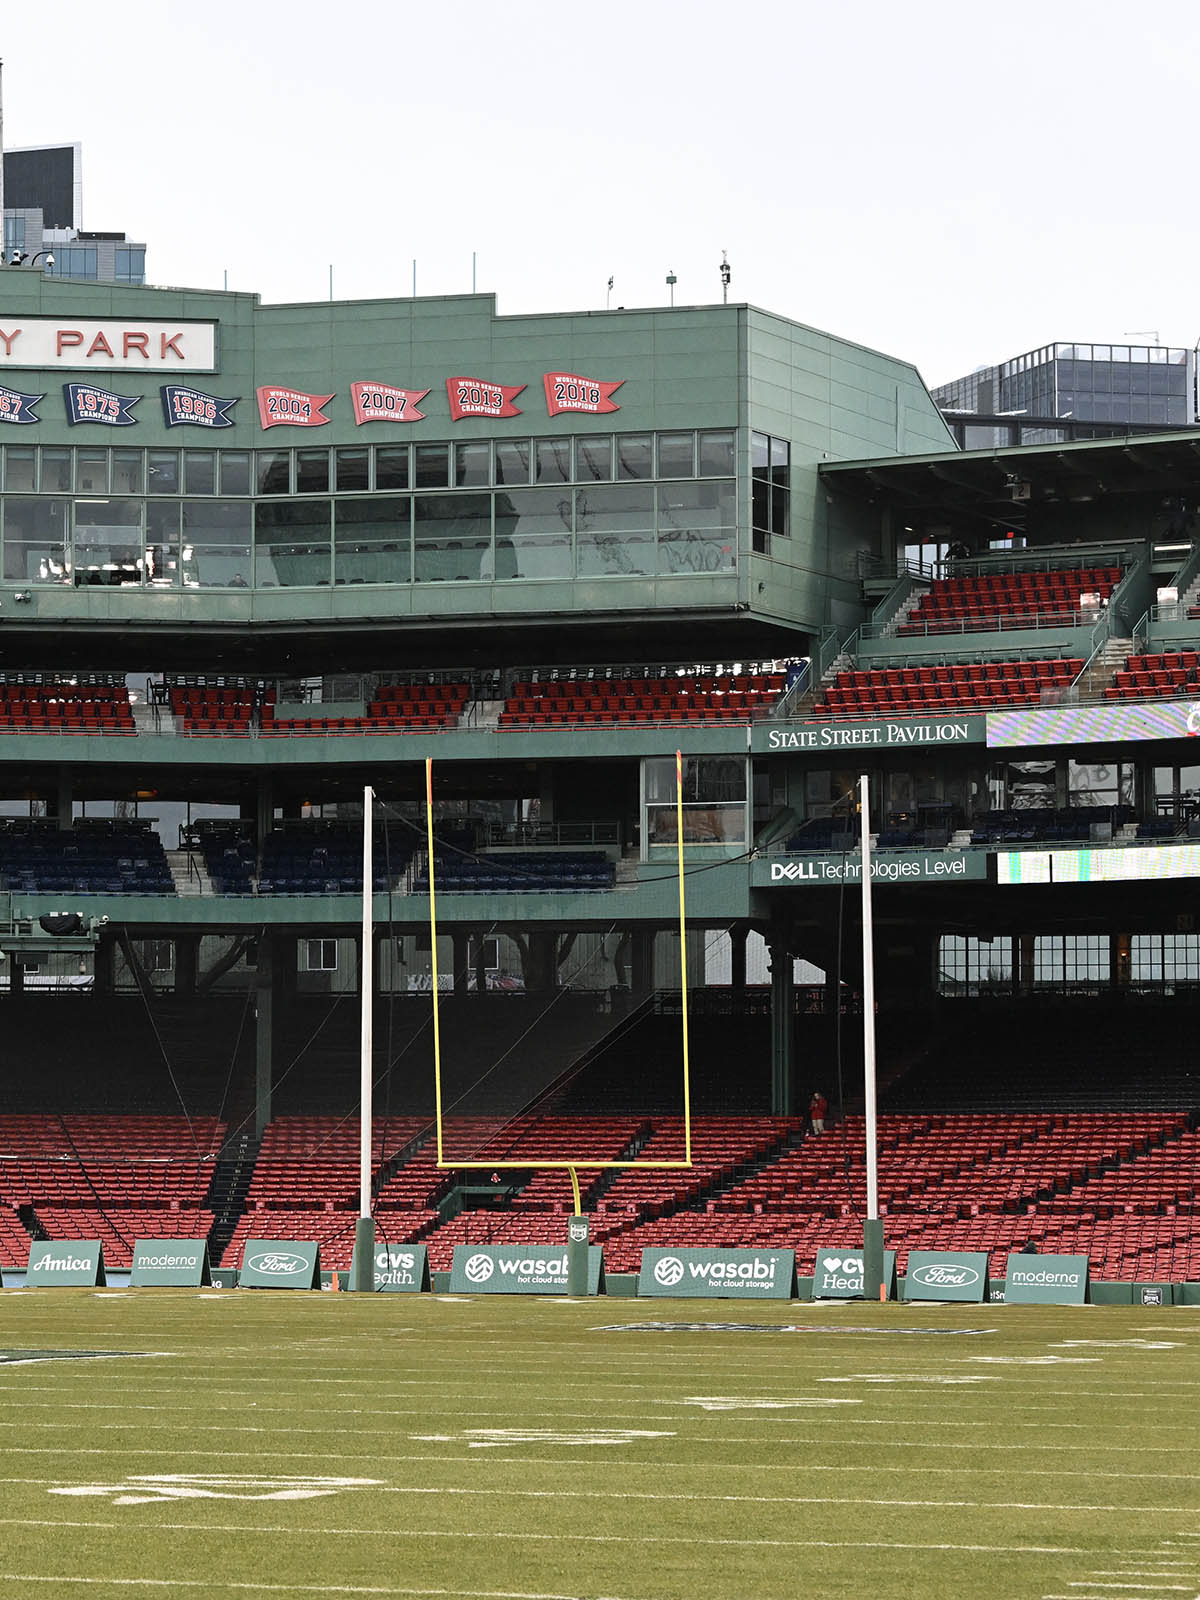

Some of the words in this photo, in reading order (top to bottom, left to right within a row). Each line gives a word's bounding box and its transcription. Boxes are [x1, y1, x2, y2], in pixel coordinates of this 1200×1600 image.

[56, 329, 186, 360] PARK
[458, 381, 480, 389] WORLD
[555, 376, 577, 384] WORLD
[77, 388, 100, 397] AMERICAN
[174, 390, 197, 398] AMERICAN
[269, 391, 290, 399] WORLD
[362, 385, 384, 393] WORLD
[554, 383, 600, 404] 2018
[360, 392, 408, 412] 2007
[457, 387, 503, 408] 2013
[77, 394, 121, 417] 1975
[173, 396, 217, 419] 1986
[268, 397, 311, 417] 2004
[461, 405, 500, 415] CHAMPIONS
[558, 401, 597, 411] CHAMPIONS
[79, 411, 116, 423] CHAMPIONS
[176, 412, 213, 425] CHAMPIONS
[272, 413, 309, 423] CHAMPIONS
[365, 409, 404, 419] CHAMPIONS
[768, 730, 818, 749] STATE
[886, 723, 969, 743] PAVILION
[770, 862, 819, 881] DELL
[925, 857, 966, 876] Level
[33, 1254, 92, 1271] Amica
[138, 1254, 197, 1266] moderna
[259, 1255, 298, 1272] Ford
[376, 1252, 415, 1269] CVS
[688, 1257, 776, 1279] wasabi
[517, 1275, 531, 1284] hot
[532, 1275, 553, 1284] cloud
[924, 1266, 966, 1284] Ford
[1012, 1271, 1079, 1284] moderna
[708, 1279, 722, 1287] hot
[723, 1279, 745, 1287] cloud
[745, 1280, 775, 1290] storage
